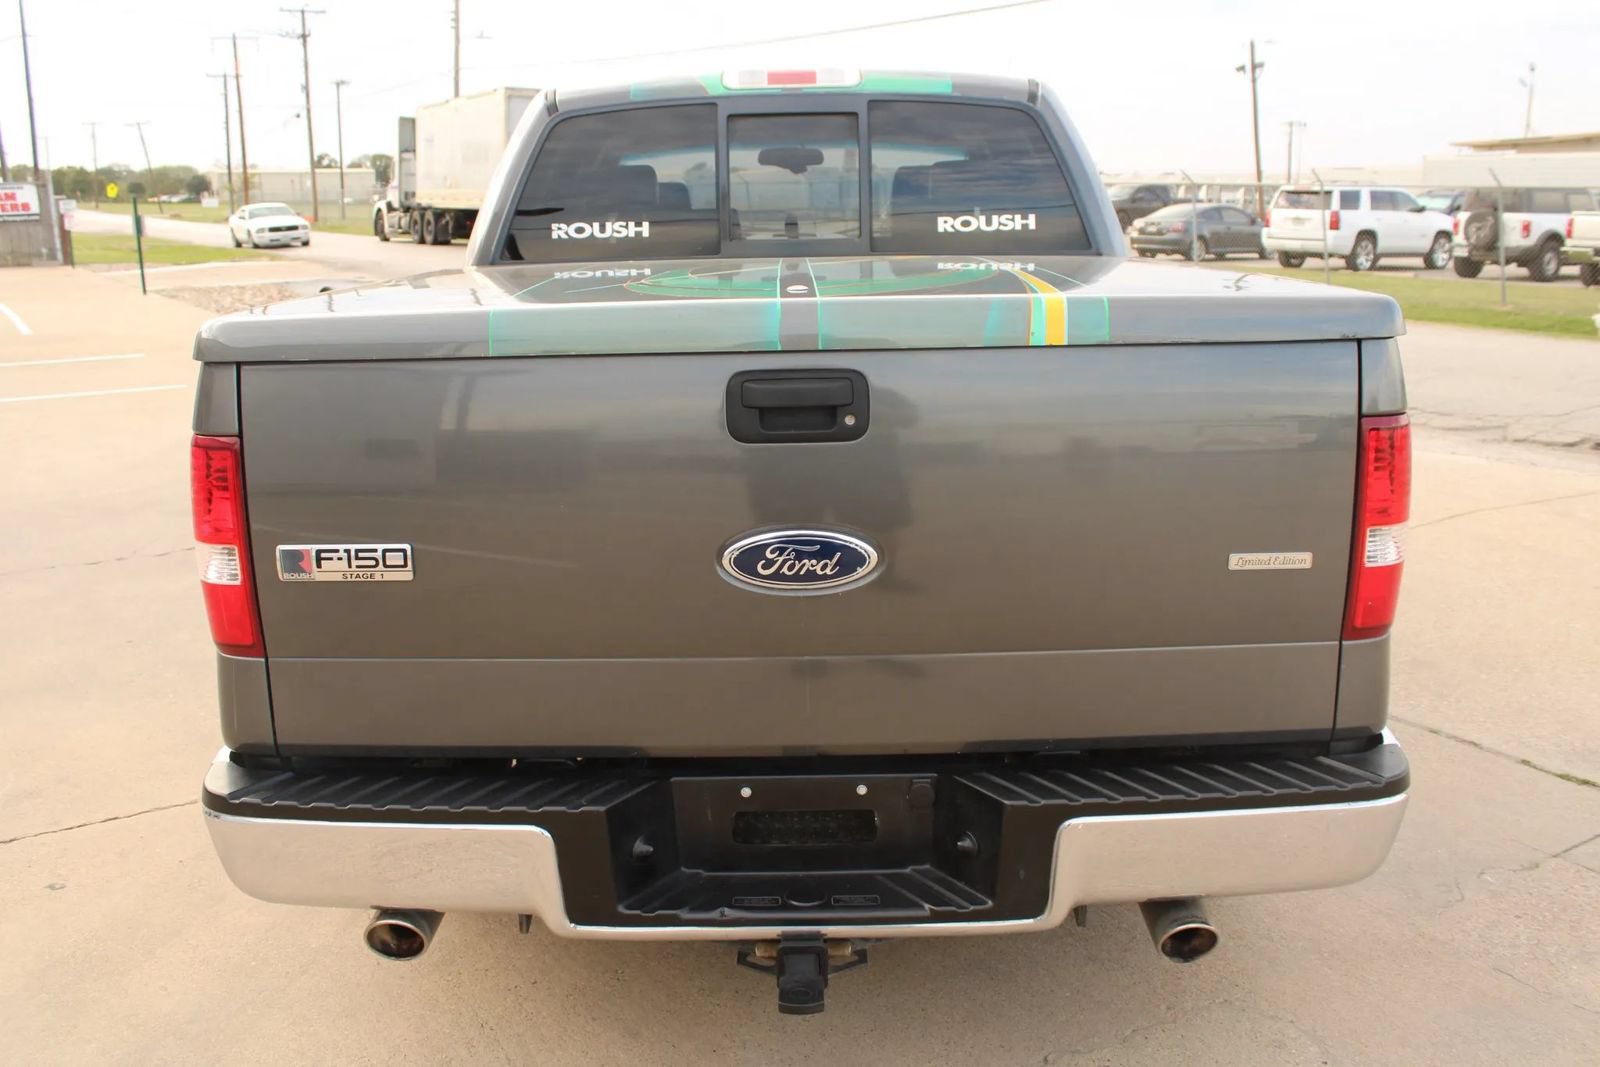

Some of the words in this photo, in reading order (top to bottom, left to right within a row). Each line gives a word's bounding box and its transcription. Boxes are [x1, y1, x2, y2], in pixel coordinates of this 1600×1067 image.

[0, 192, 16, 201] M
[551, 222, 650, 239] ROUSH
[937, 214, 1036, 232] ROUSH
[315, 548, 409, 569] F-150
[757, 544, 842, 575] Ford
[1234, 557, 1271, 567] Limited
[1272, 556, 1307, 566] Edition
